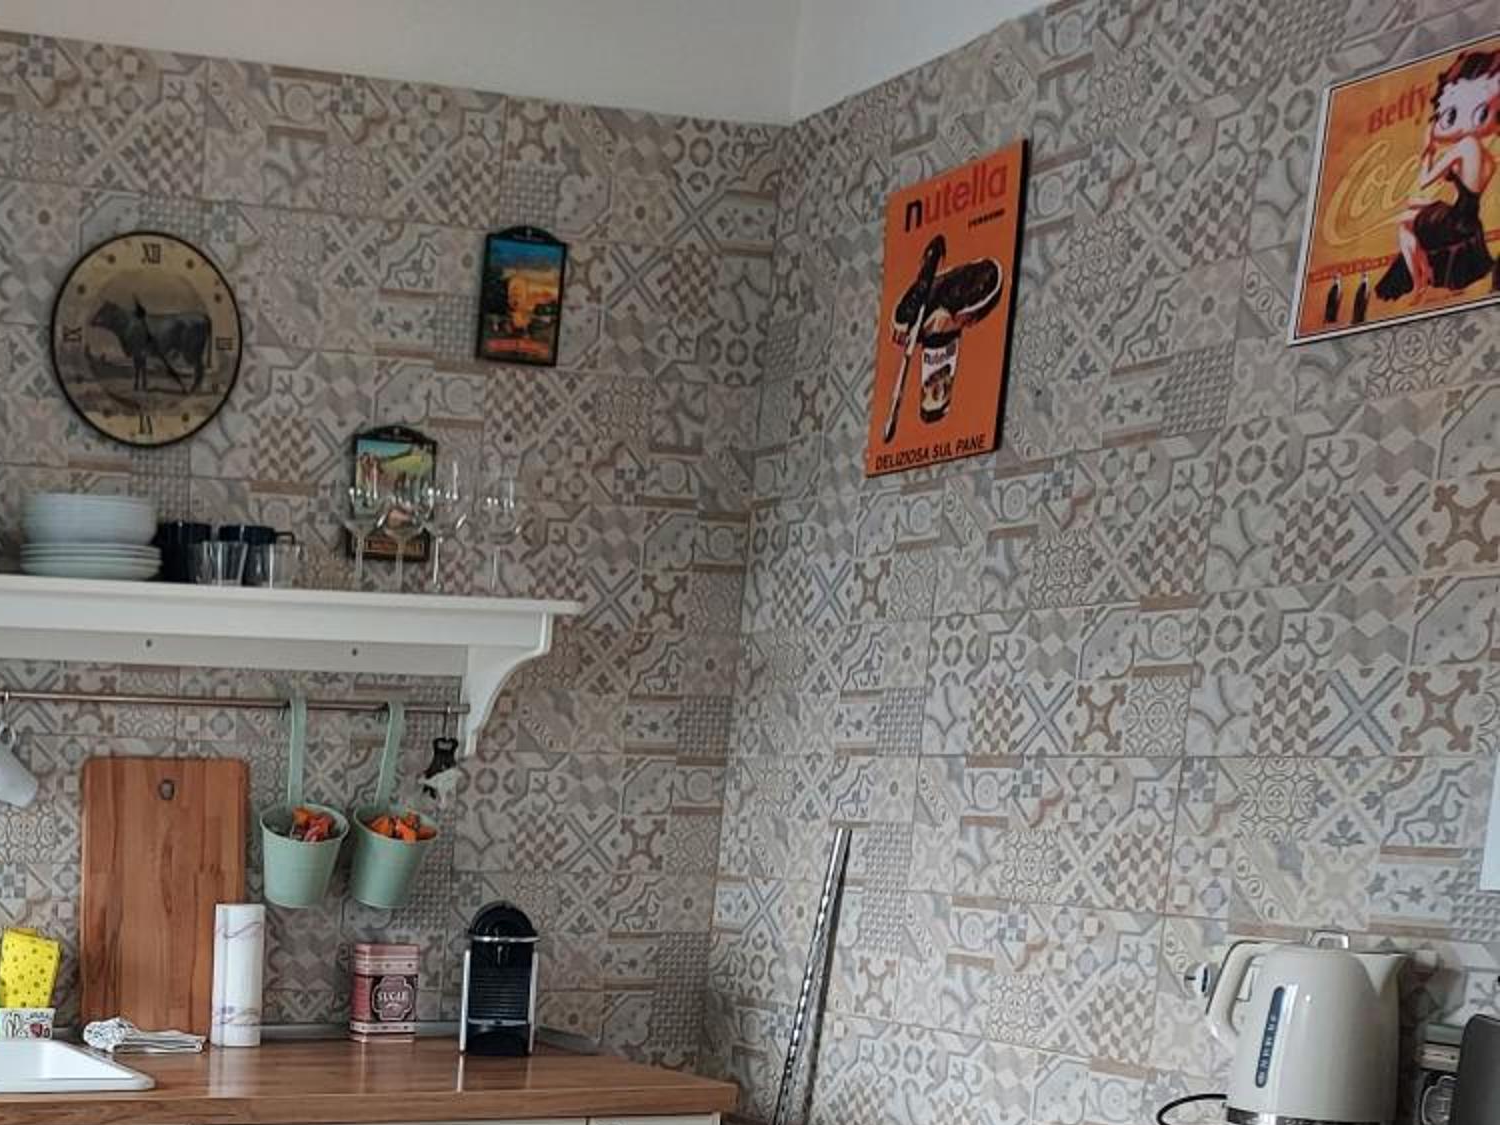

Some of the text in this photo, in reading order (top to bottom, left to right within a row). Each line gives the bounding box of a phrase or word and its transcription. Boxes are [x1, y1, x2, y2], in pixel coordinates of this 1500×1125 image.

[904, 162, 1008, 233] nutella
[932, 440, 952, 458] SUL
[955, 433, 986, 456] PANE
